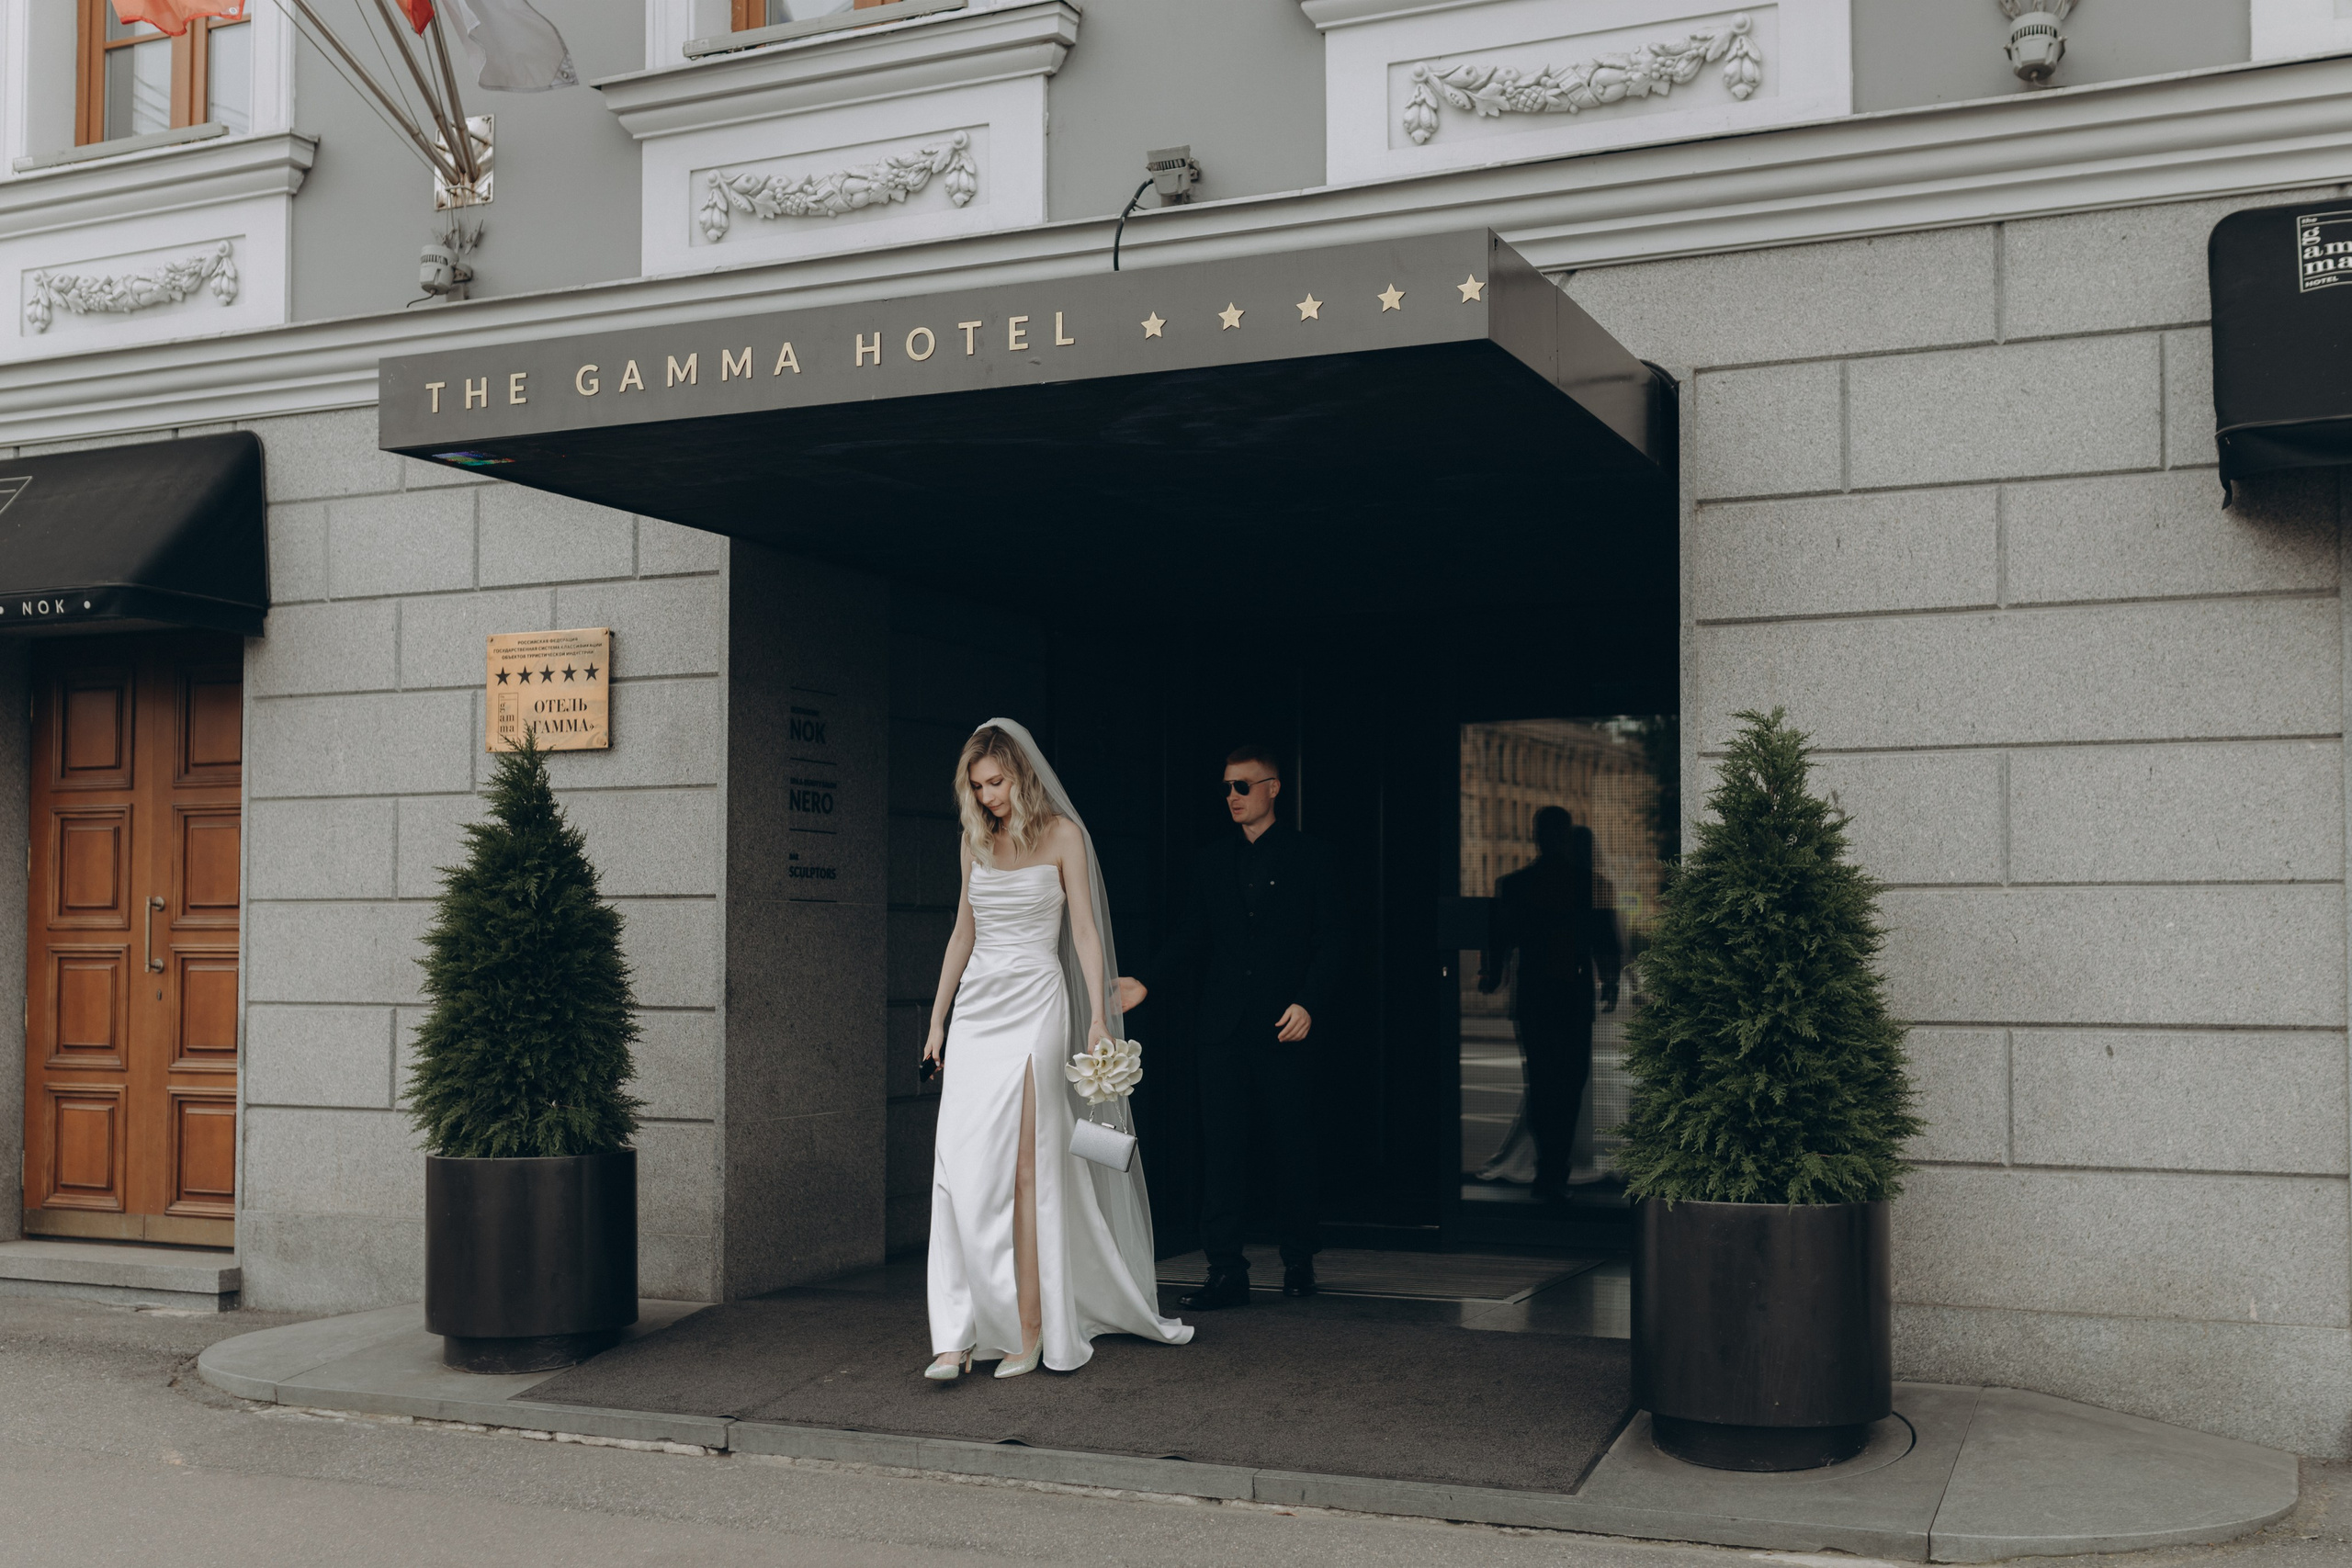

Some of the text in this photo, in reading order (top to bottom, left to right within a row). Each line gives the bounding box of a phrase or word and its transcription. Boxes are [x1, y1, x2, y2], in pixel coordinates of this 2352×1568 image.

[2304, 276, 2339, 288] HOTEL
[425, 311, 1076, 413] THE GAMMA HOTEL
[22, 599, 65, 616] NOK
[534, 698, 588, 714] ОТЕЛЬ
[531, 717, 595, 734] ГАММА»
[790, 717, 826, 744] NOK
[789, 789, 833, 814] NERO
[789, 865, 836, 879] SCULPTORS
